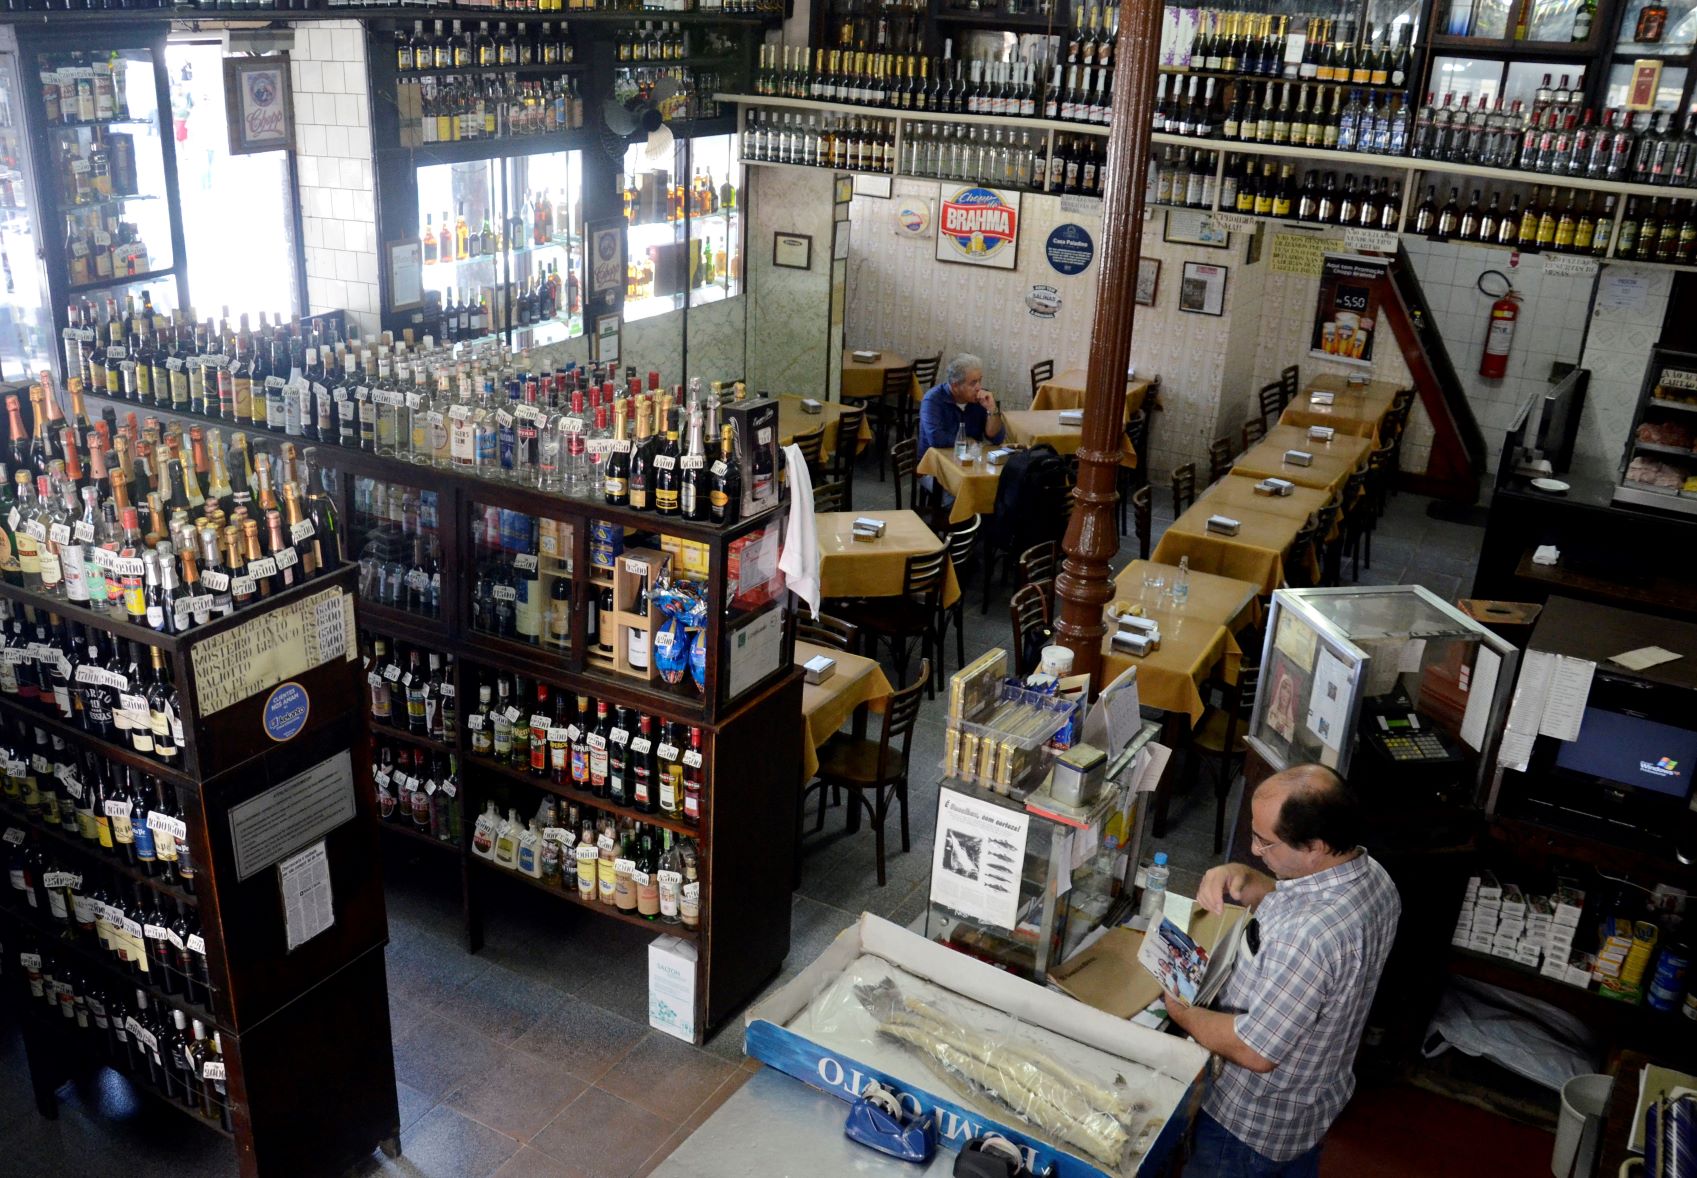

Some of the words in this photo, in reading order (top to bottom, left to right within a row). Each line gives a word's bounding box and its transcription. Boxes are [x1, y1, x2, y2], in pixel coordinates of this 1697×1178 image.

[246, 109, 283, 136] Chopp
[958, 192, 997, 205] Chopp
[947, 207, 1010, 234] BRAHMA
[1052, 237, 1066, 245] Casa
[1326, 262, 1340, 270] Aqui
[1354, 265, 1384, 276] Promoção
[1344, 295, 1365, 308] 5,50
[256, 618, 287, 642] TINTO
[273, 688, 295, 703] CLIENTES
[1640, 762, 1674, 776] Windows
[981, 815, 994, 824] com
